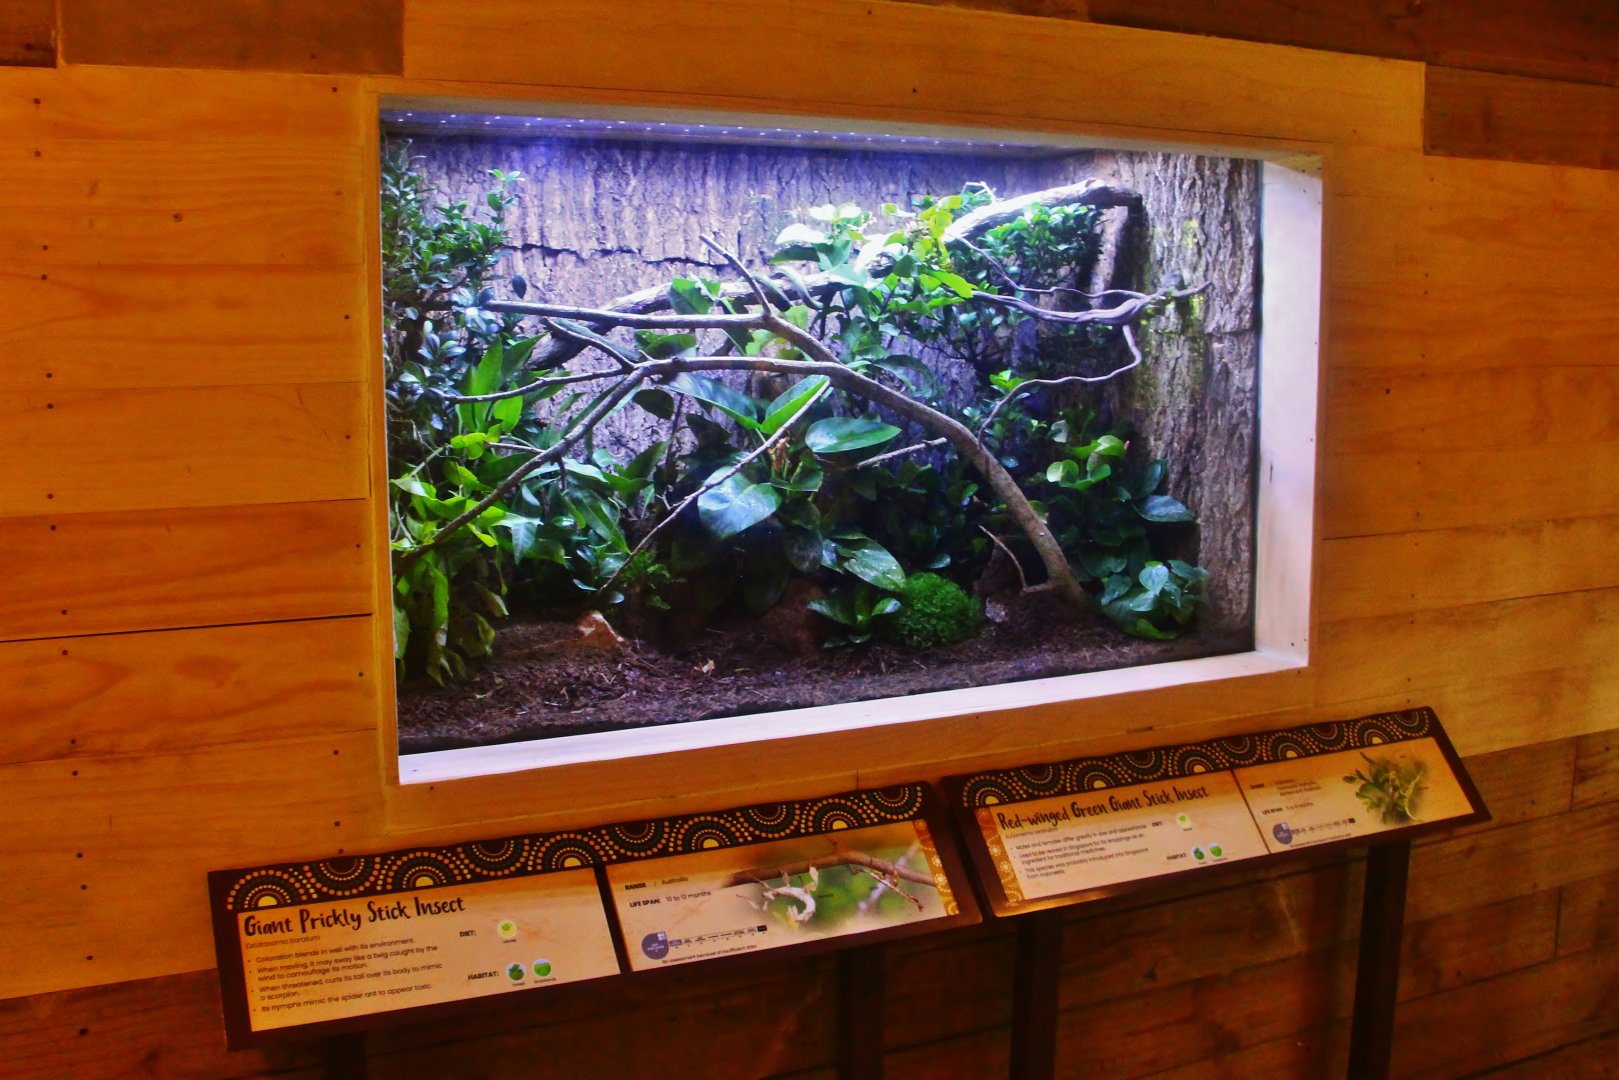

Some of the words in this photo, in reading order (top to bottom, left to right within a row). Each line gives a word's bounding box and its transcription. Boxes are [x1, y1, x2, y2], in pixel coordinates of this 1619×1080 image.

[997, 807, 1070, 830] Red-winged
[1071, 801, 1108, 818] Green
[1109, 795, 1142, 812] Giant
[1142, 790, 1174, 806] Stick
[1173, 786, 1209, 801] Insect
[688, 890, 711, 899] months
[244, 915, 293, 936] Giant
[299, 909, 361, 933] Prickly
[367, 901, 410, 922] Stick
[414, 897, 465, 916] Insect
